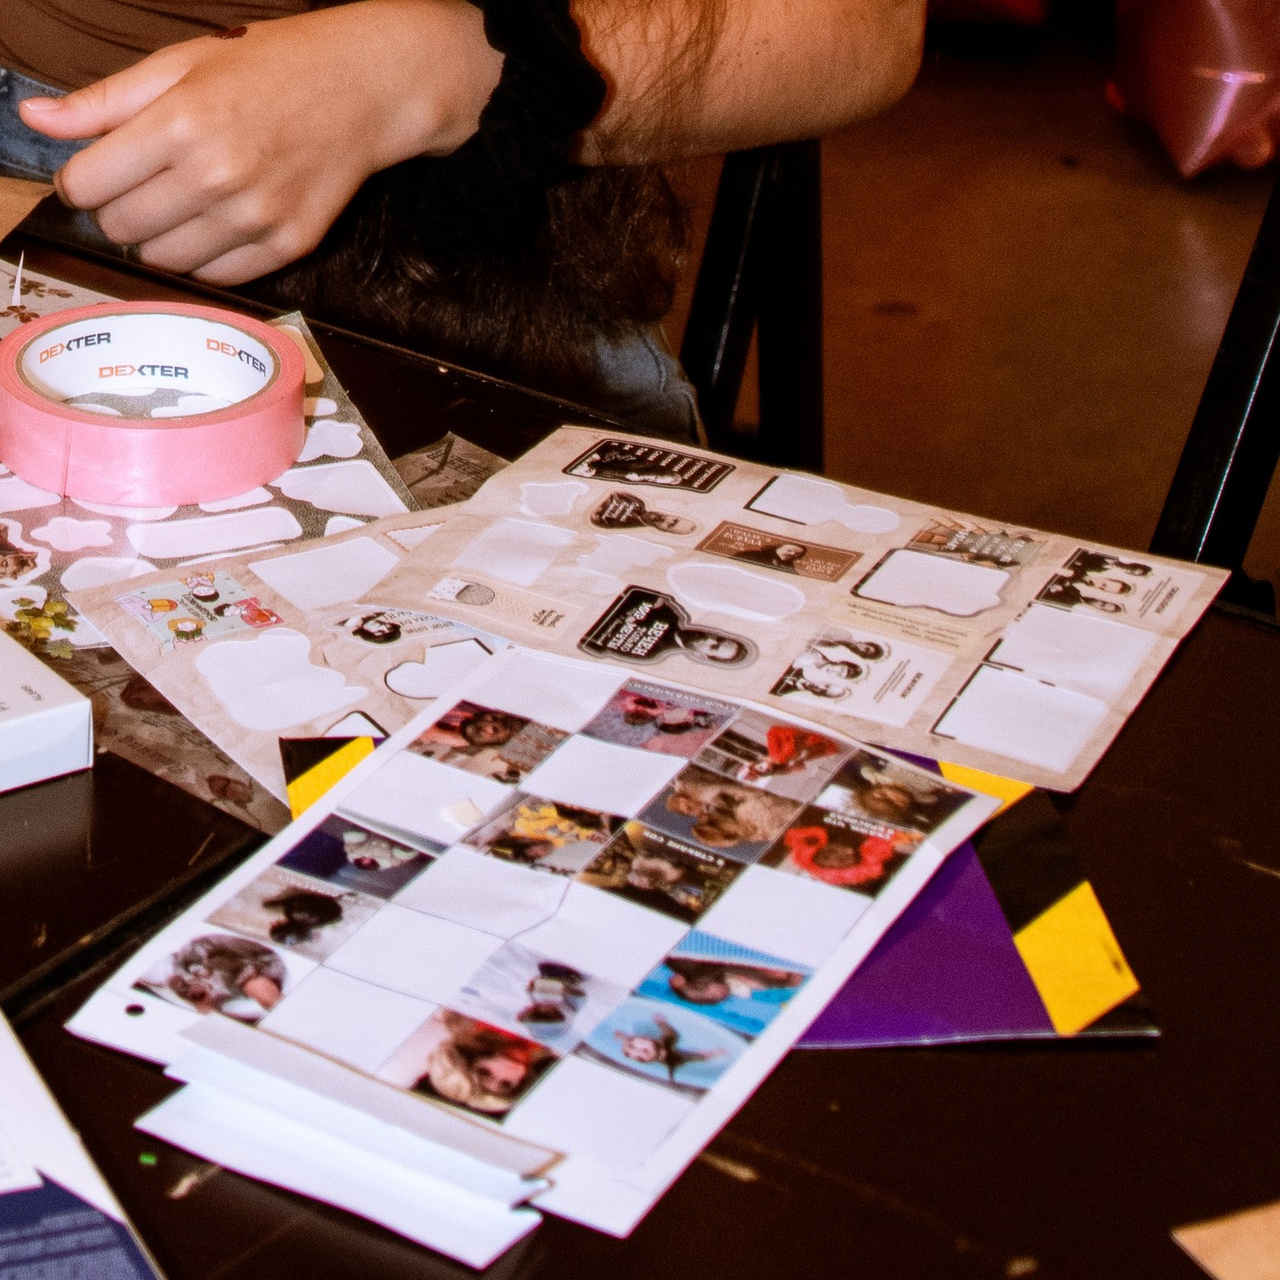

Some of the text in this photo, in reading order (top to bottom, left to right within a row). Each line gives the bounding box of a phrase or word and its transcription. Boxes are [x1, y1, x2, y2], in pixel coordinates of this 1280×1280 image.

[39, 332, 111, 365] DEXTER
[206, 338, 267, 377] DEXTER
[98, 365, 189, 379] DEXTER
[631, 621, 669, 656] ВЕЧЕН
